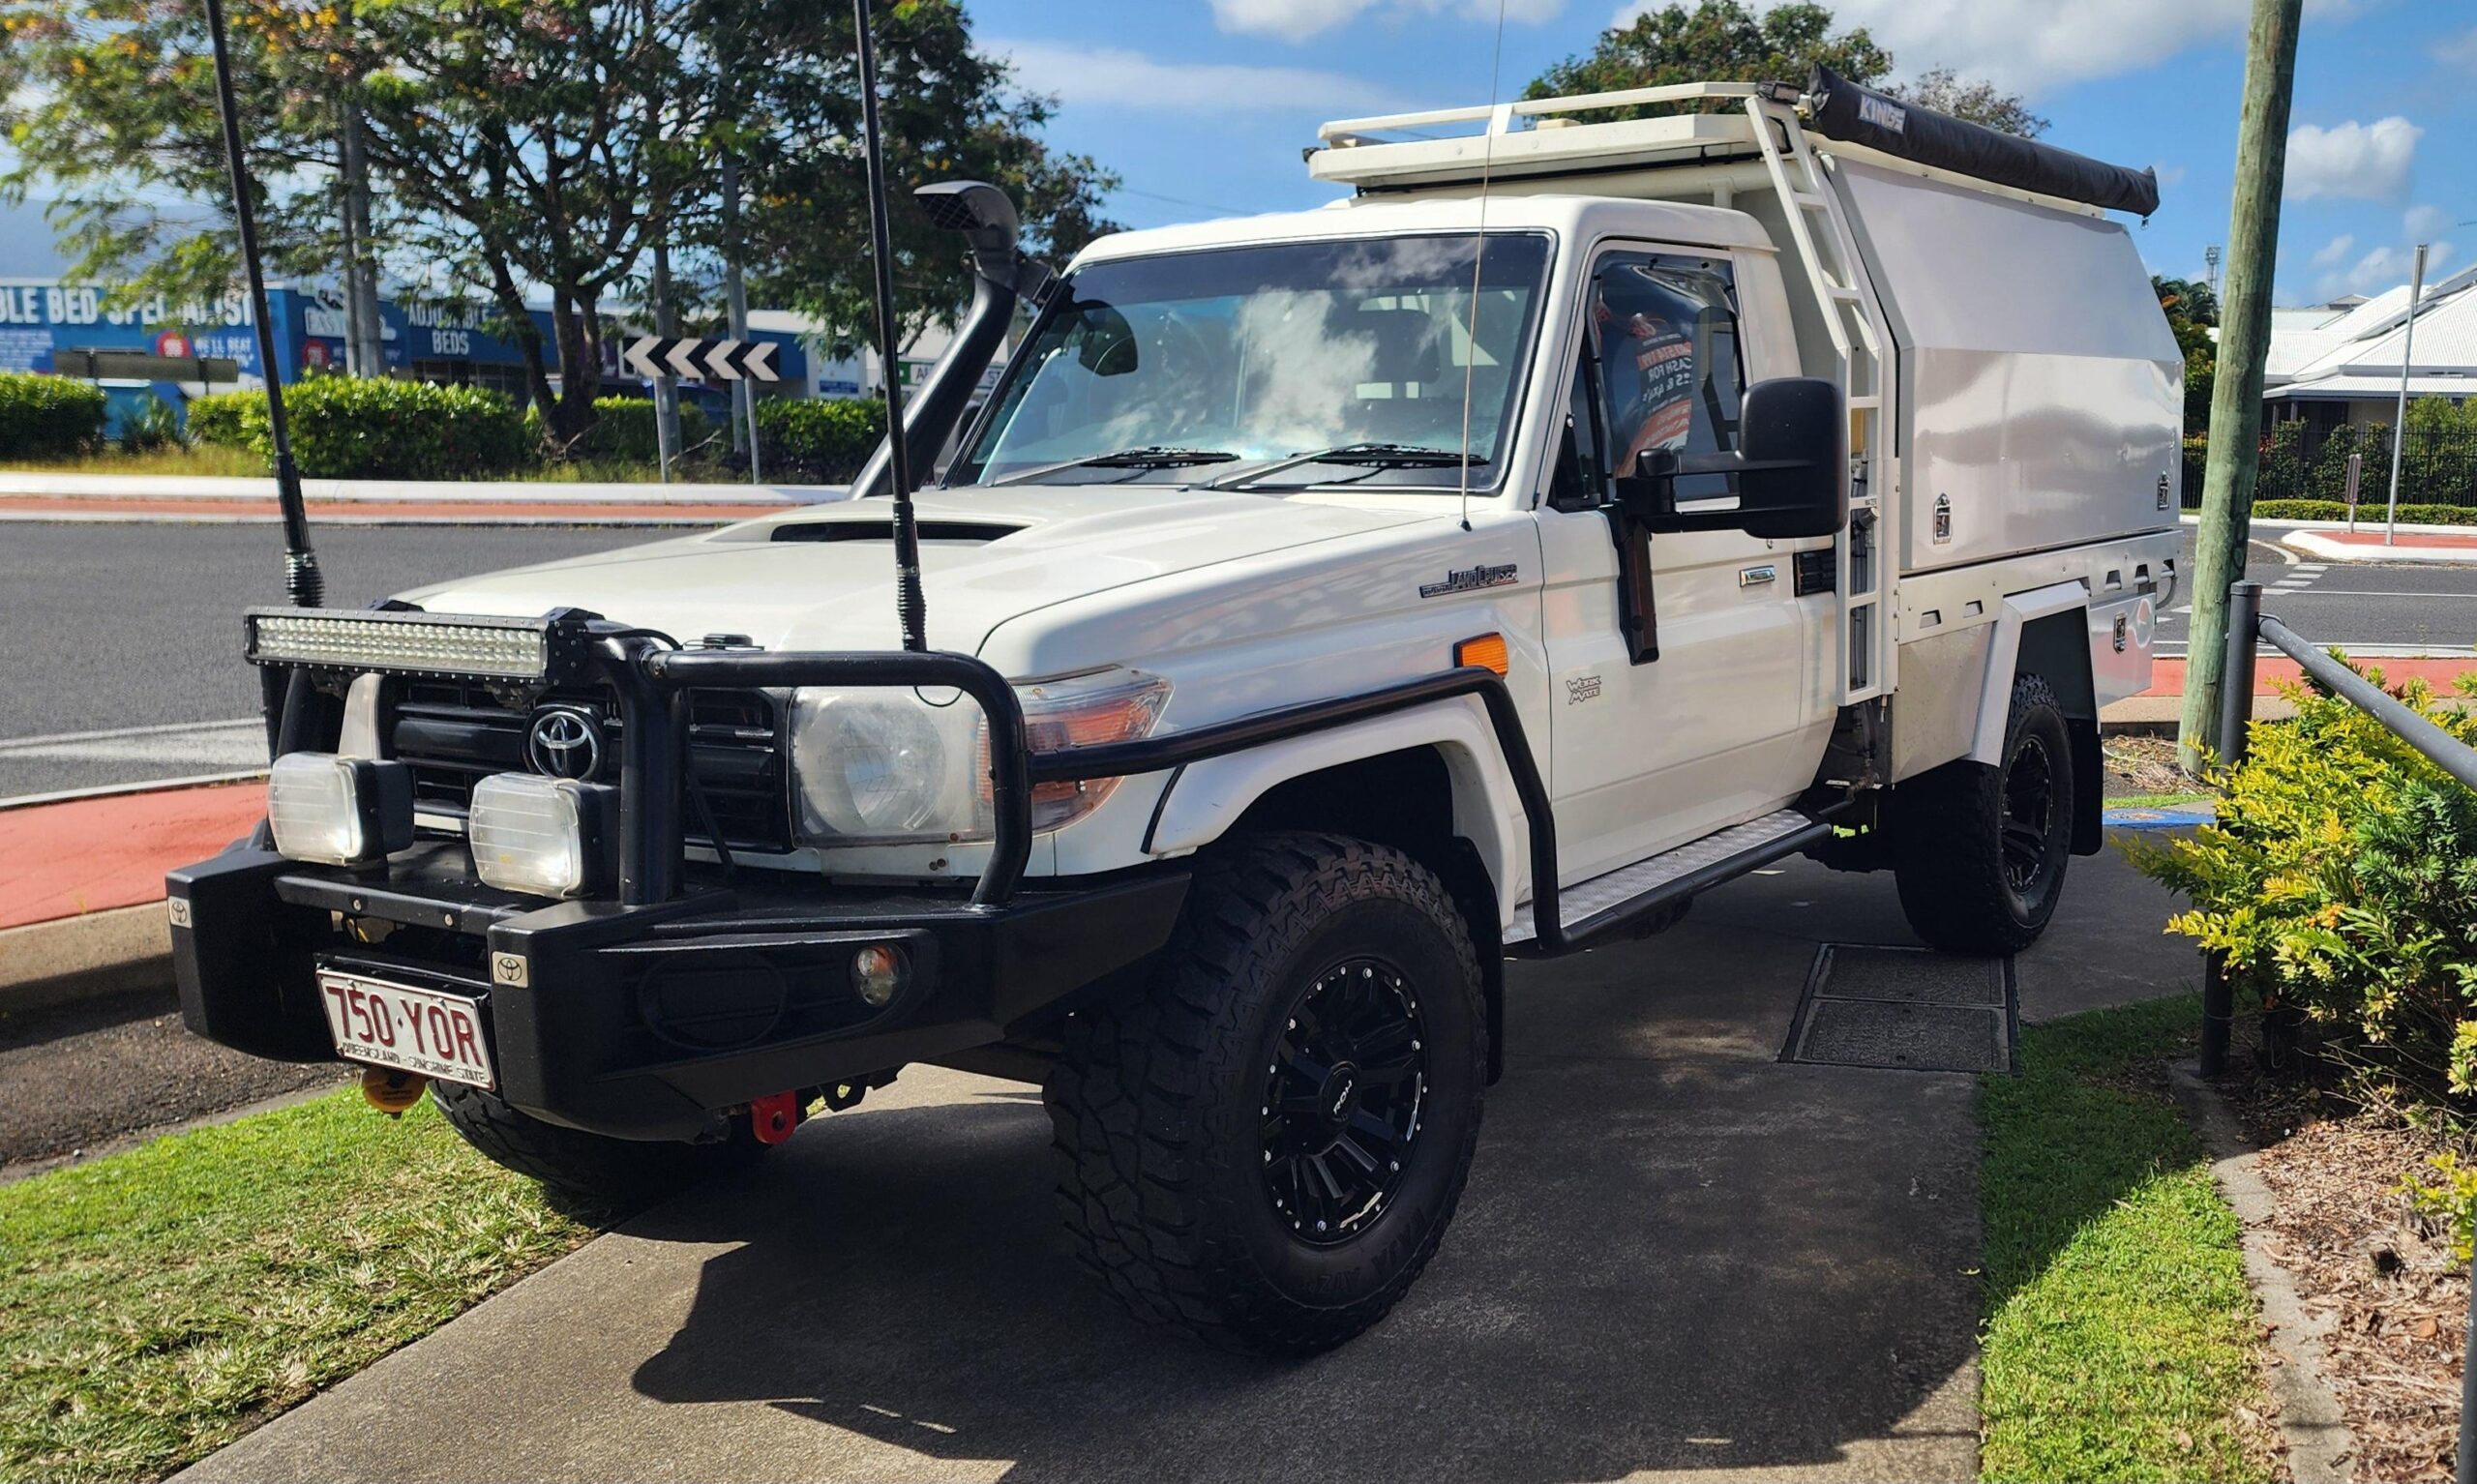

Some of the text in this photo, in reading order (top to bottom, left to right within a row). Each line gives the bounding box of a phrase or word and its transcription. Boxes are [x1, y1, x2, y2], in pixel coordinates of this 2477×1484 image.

[46, 286, 98, 324] BED
[432, 330, 469, 355] BEDS
[457, 1067, 487, 1083] STATE
